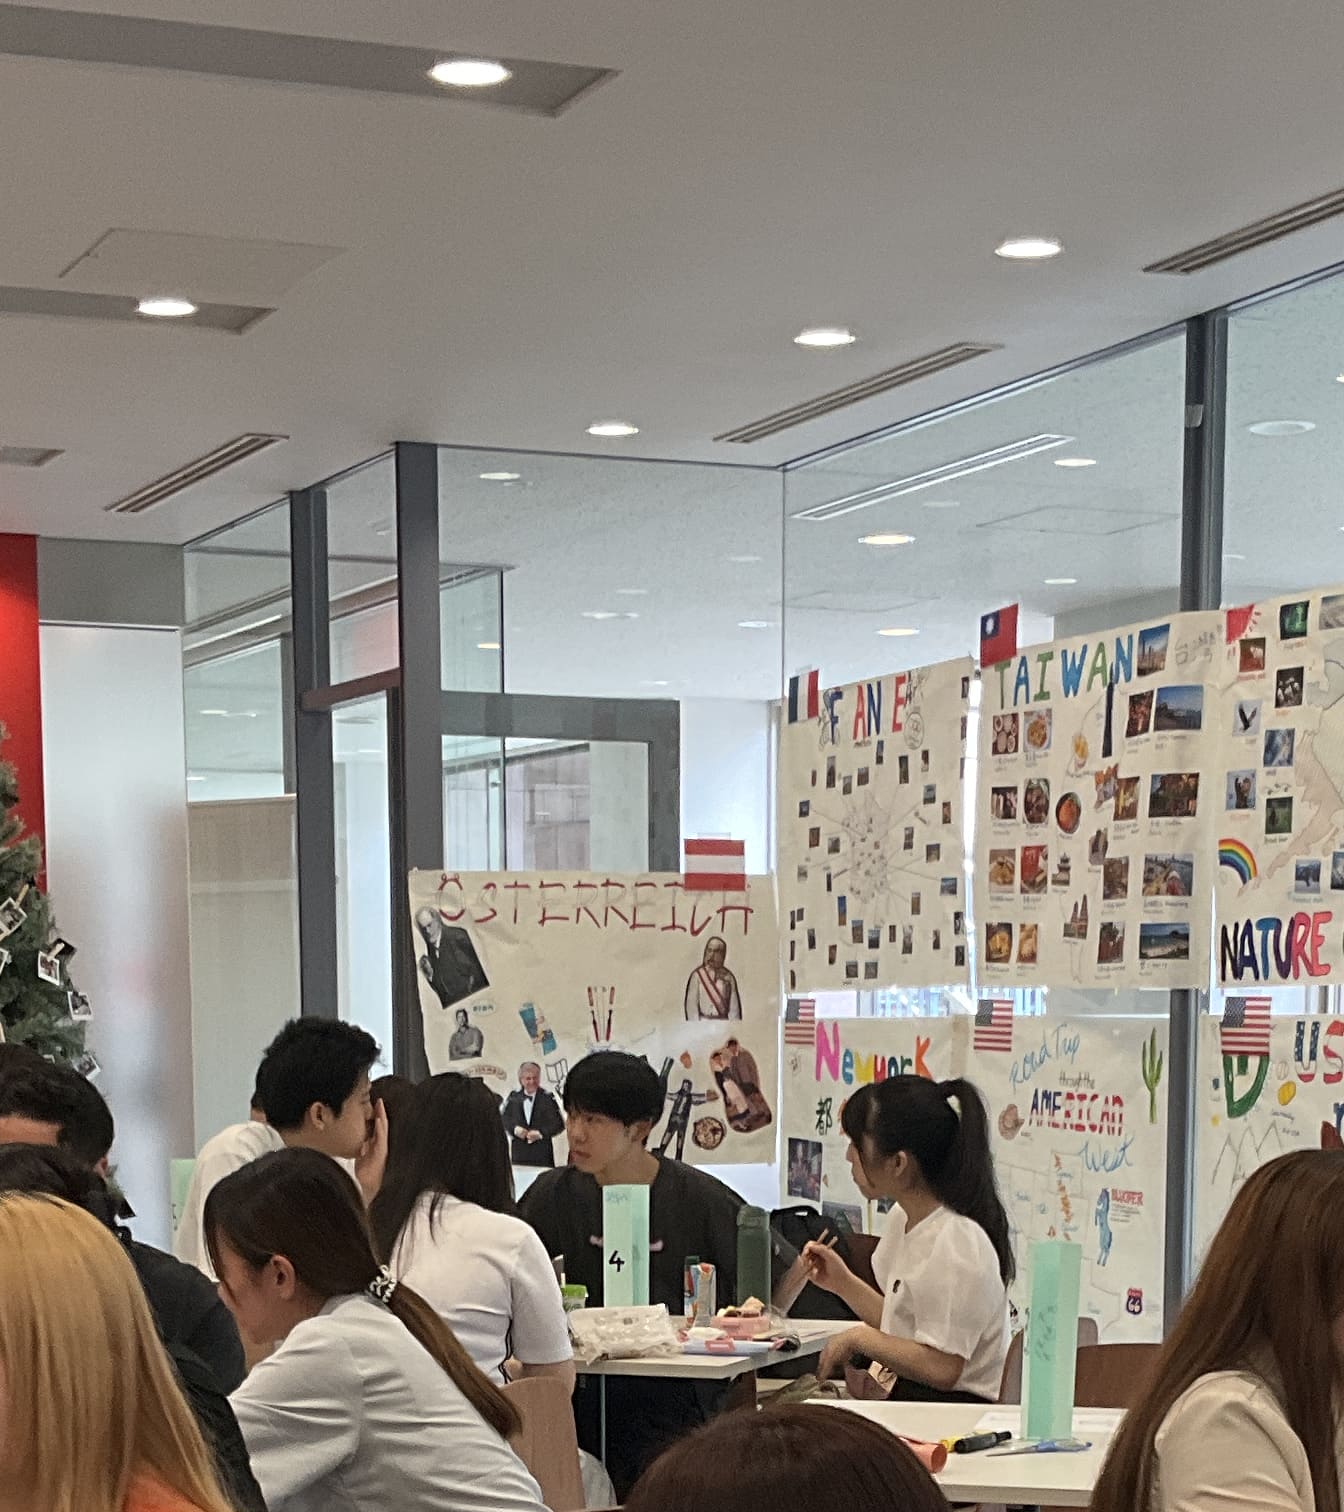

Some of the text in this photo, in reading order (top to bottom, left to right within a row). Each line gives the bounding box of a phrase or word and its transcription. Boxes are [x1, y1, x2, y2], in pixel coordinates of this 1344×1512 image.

[994, 634, 1134, 710] TAIWAN
[1220, 910, 1333, 982] NATURE
[1028, 1087, 1124, 1137] AMERICAN
[1077, 1132, 1135, 1173] West
[608, 1250, 625, 1273] 4
[1127, 1301, 1141, 1313] 66
